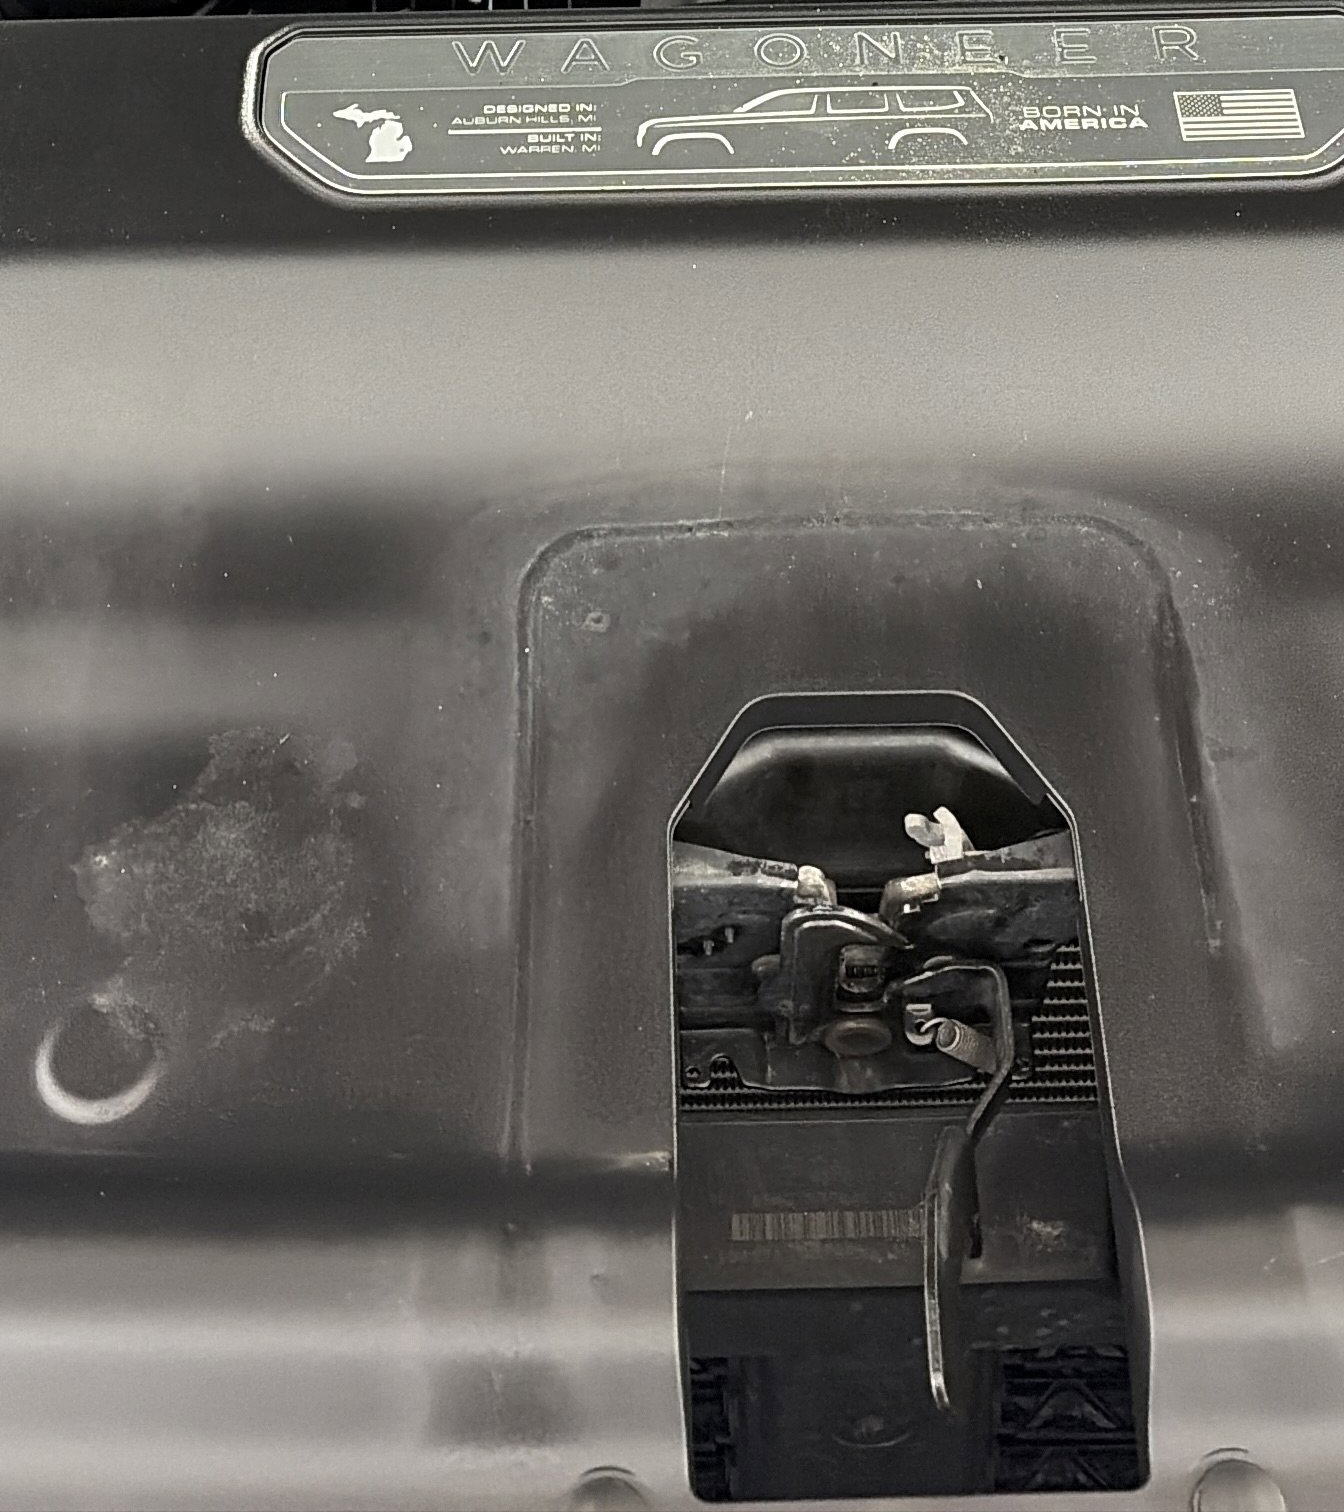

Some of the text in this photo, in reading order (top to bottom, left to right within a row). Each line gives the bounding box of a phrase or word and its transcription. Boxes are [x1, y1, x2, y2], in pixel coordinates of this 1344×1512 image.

[451, 24, 1201, 76] WAGONEER
[483, 102, 597, 114] DESIGNED IN:
[1022, 104, 1139, 118] BORN IN
[451, 115, 522, 125] AUBURN
[577, 114, 597, 123] MI
[1019, 117, 1148, 131] AMERICA
[527, 133, 602, 143] BUILT IN:
[582, 144, 601, 153] MI
